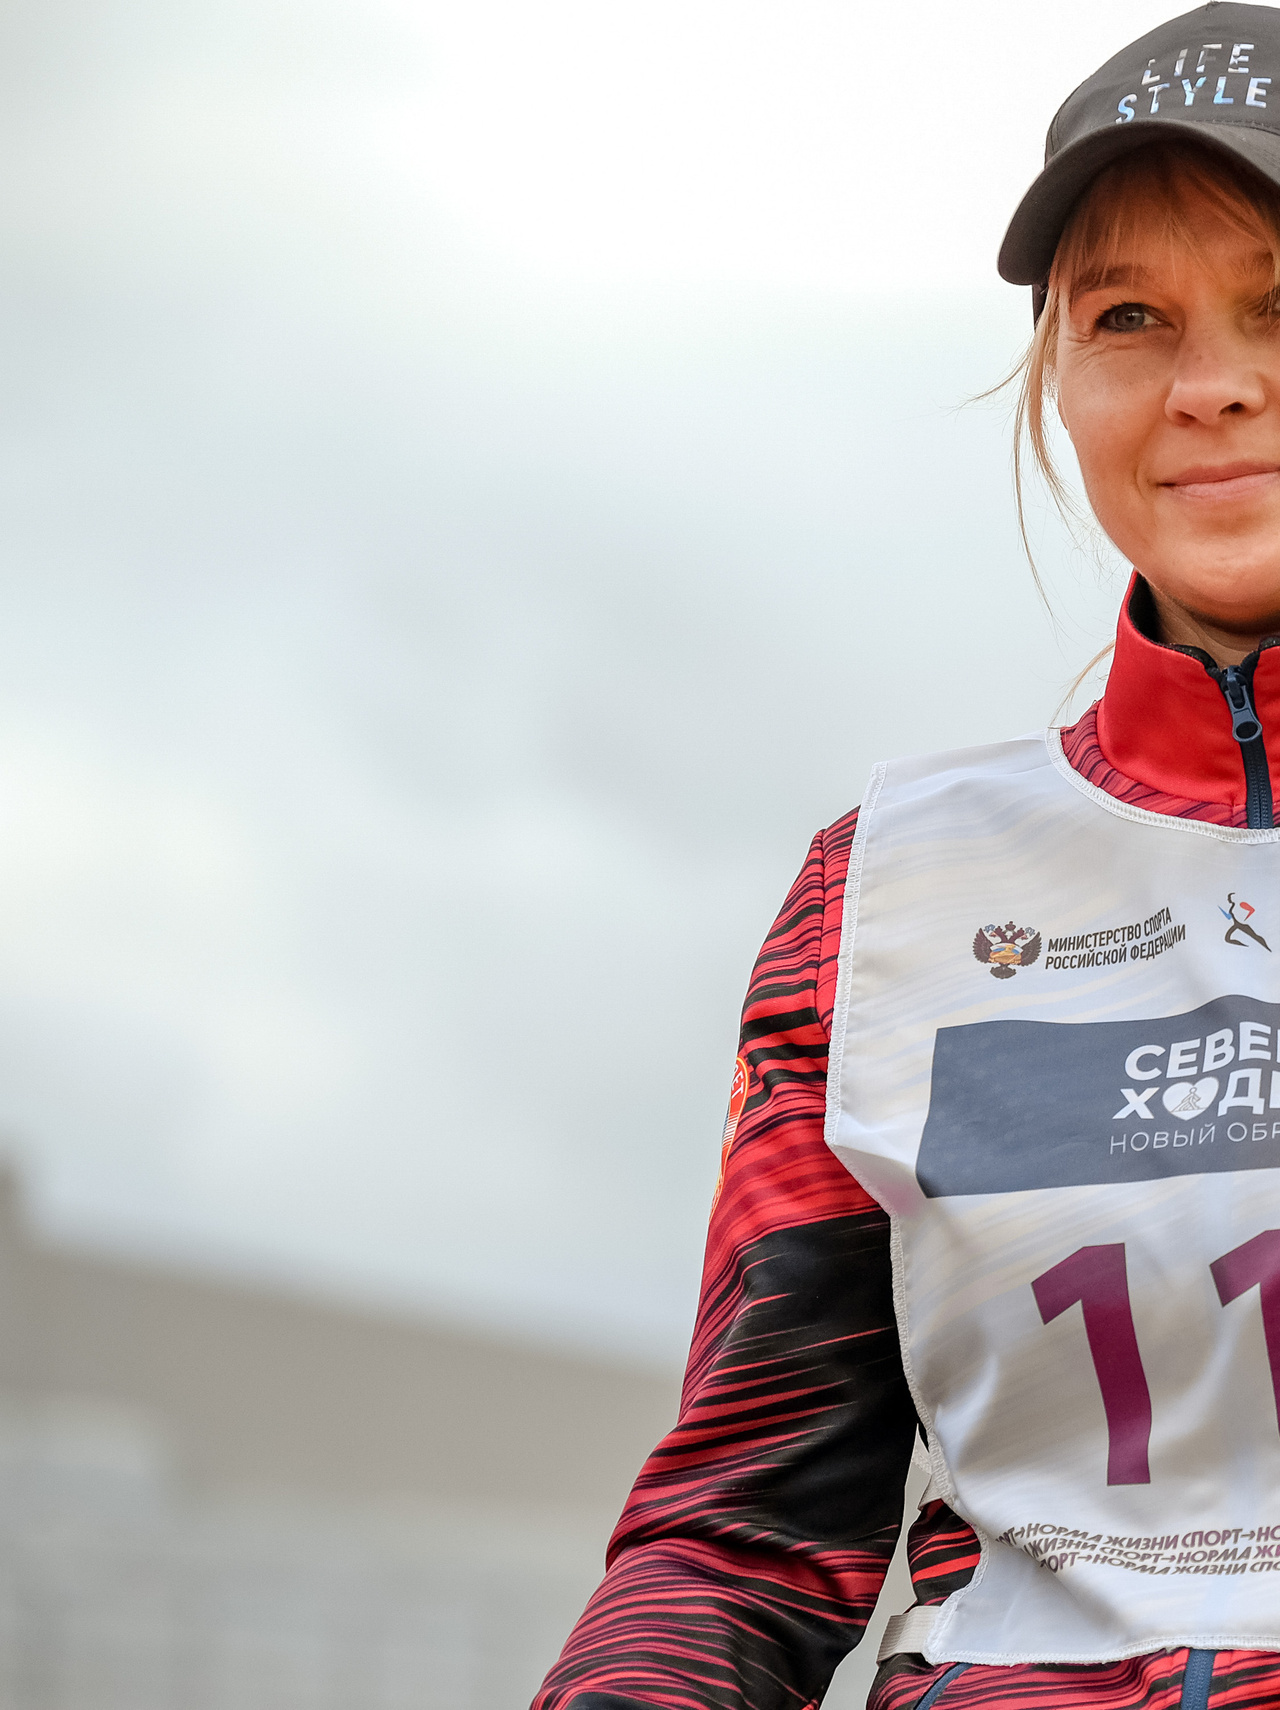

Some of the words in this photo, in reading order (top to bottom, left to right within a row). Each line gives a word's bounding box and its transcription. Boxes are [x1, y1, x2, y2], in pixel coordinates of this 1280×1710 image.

[1141, 43, 1255, 86] LIFE
[1115, 76, 1272, 124] STYLE
[1045, 943, 1127, 970] РОССИЙСКОЙ
[1130, 924, 1186, 961] ФЕДЕРАЦИИ
[1047, 922, 1141, 952] МИНИСТЕРСТВО
[1144, 906, 1172, 937] СПОРТА
[1109, 1122, 1216, 1155] НОВЫЙ
[1102, 1534, 1179, 1550] ЖИЗНИ
[1171, 1563, 1247, 1575] ЖИЗНИ
